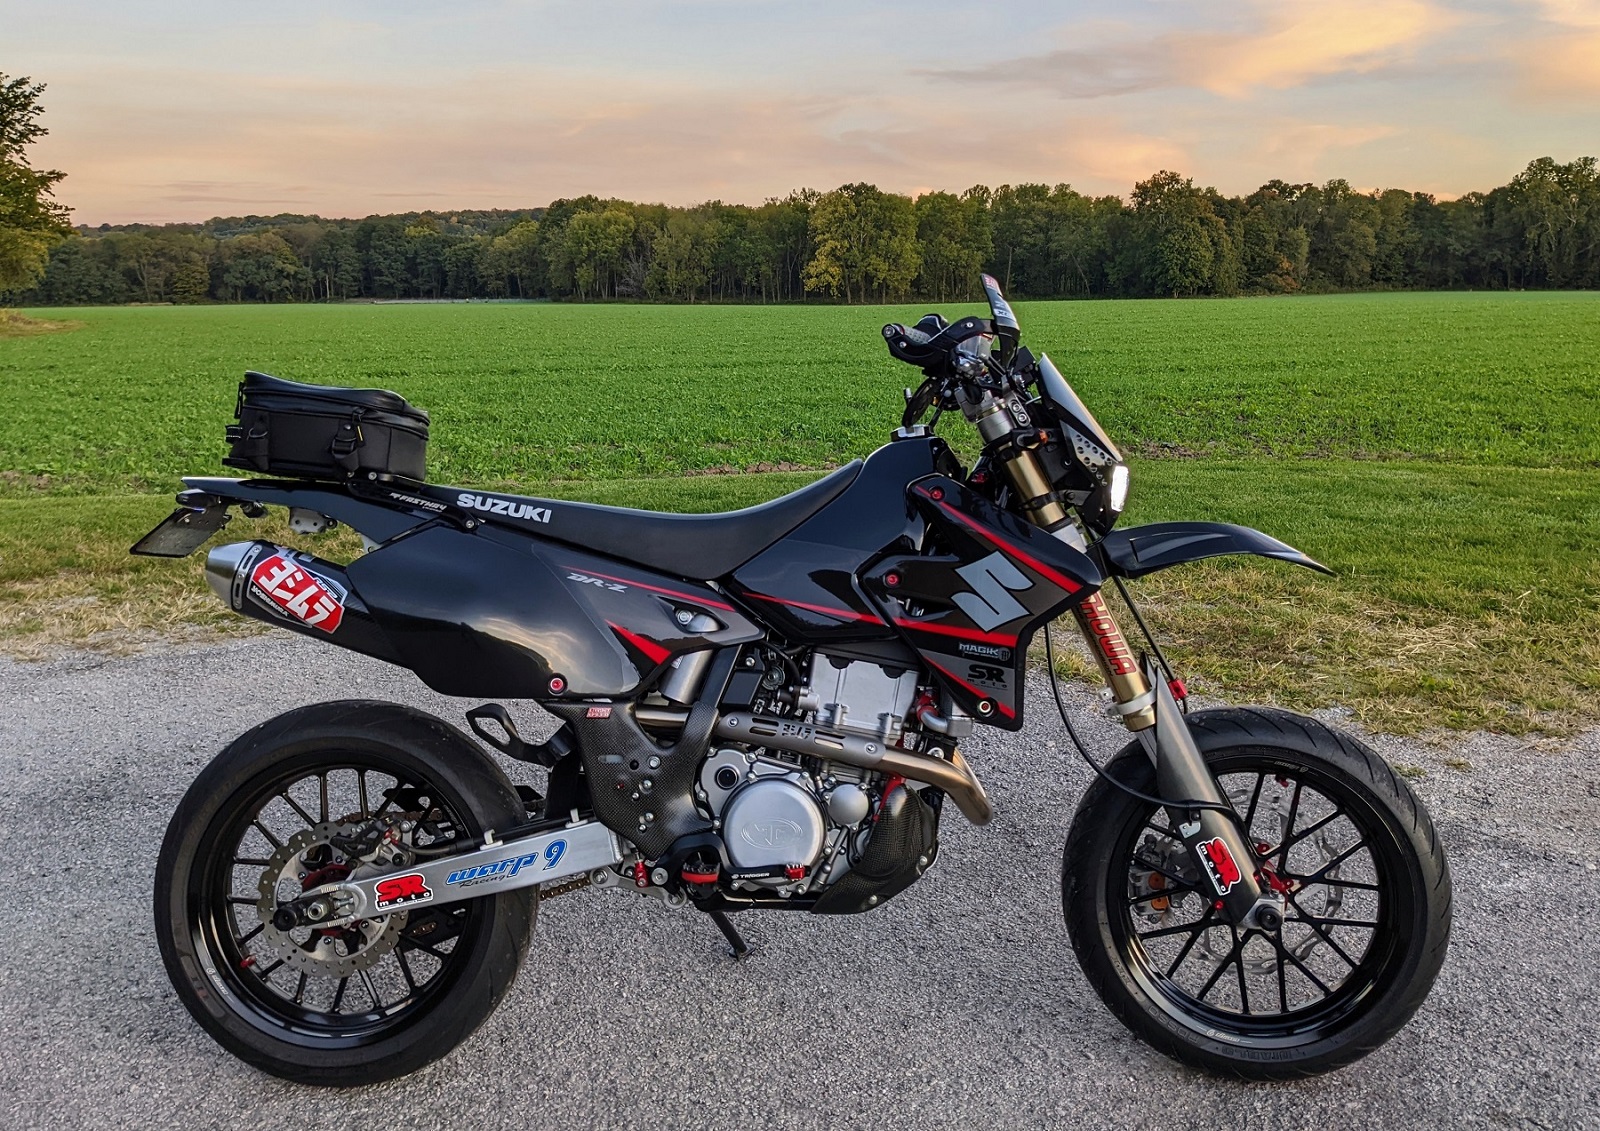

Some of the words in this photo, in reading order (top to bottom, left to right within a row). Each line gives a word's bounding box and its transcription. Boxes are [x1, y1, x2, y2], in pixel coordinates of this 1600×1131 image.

[457, 493, 552, 523] SUZUKI
[258, 560, 336, 625] ヨシムラ
[566, 572, 628, 594] DR-Z
[1080, 591, 1136, 676] HOWA
[959, 643, 999, 656] MAGIK
[968, 664, 1006, 683] SR
[446, 852, 539, 885] warp
[543, 839, 568, 871] 9
[1201, 845, 1226, 892] moto
[1205, 838, 1239, 888] SR
[376, 874, 428, 901] SR
[460, 874, 508, 888] Racing
[379, 891, 430, 907] moto
